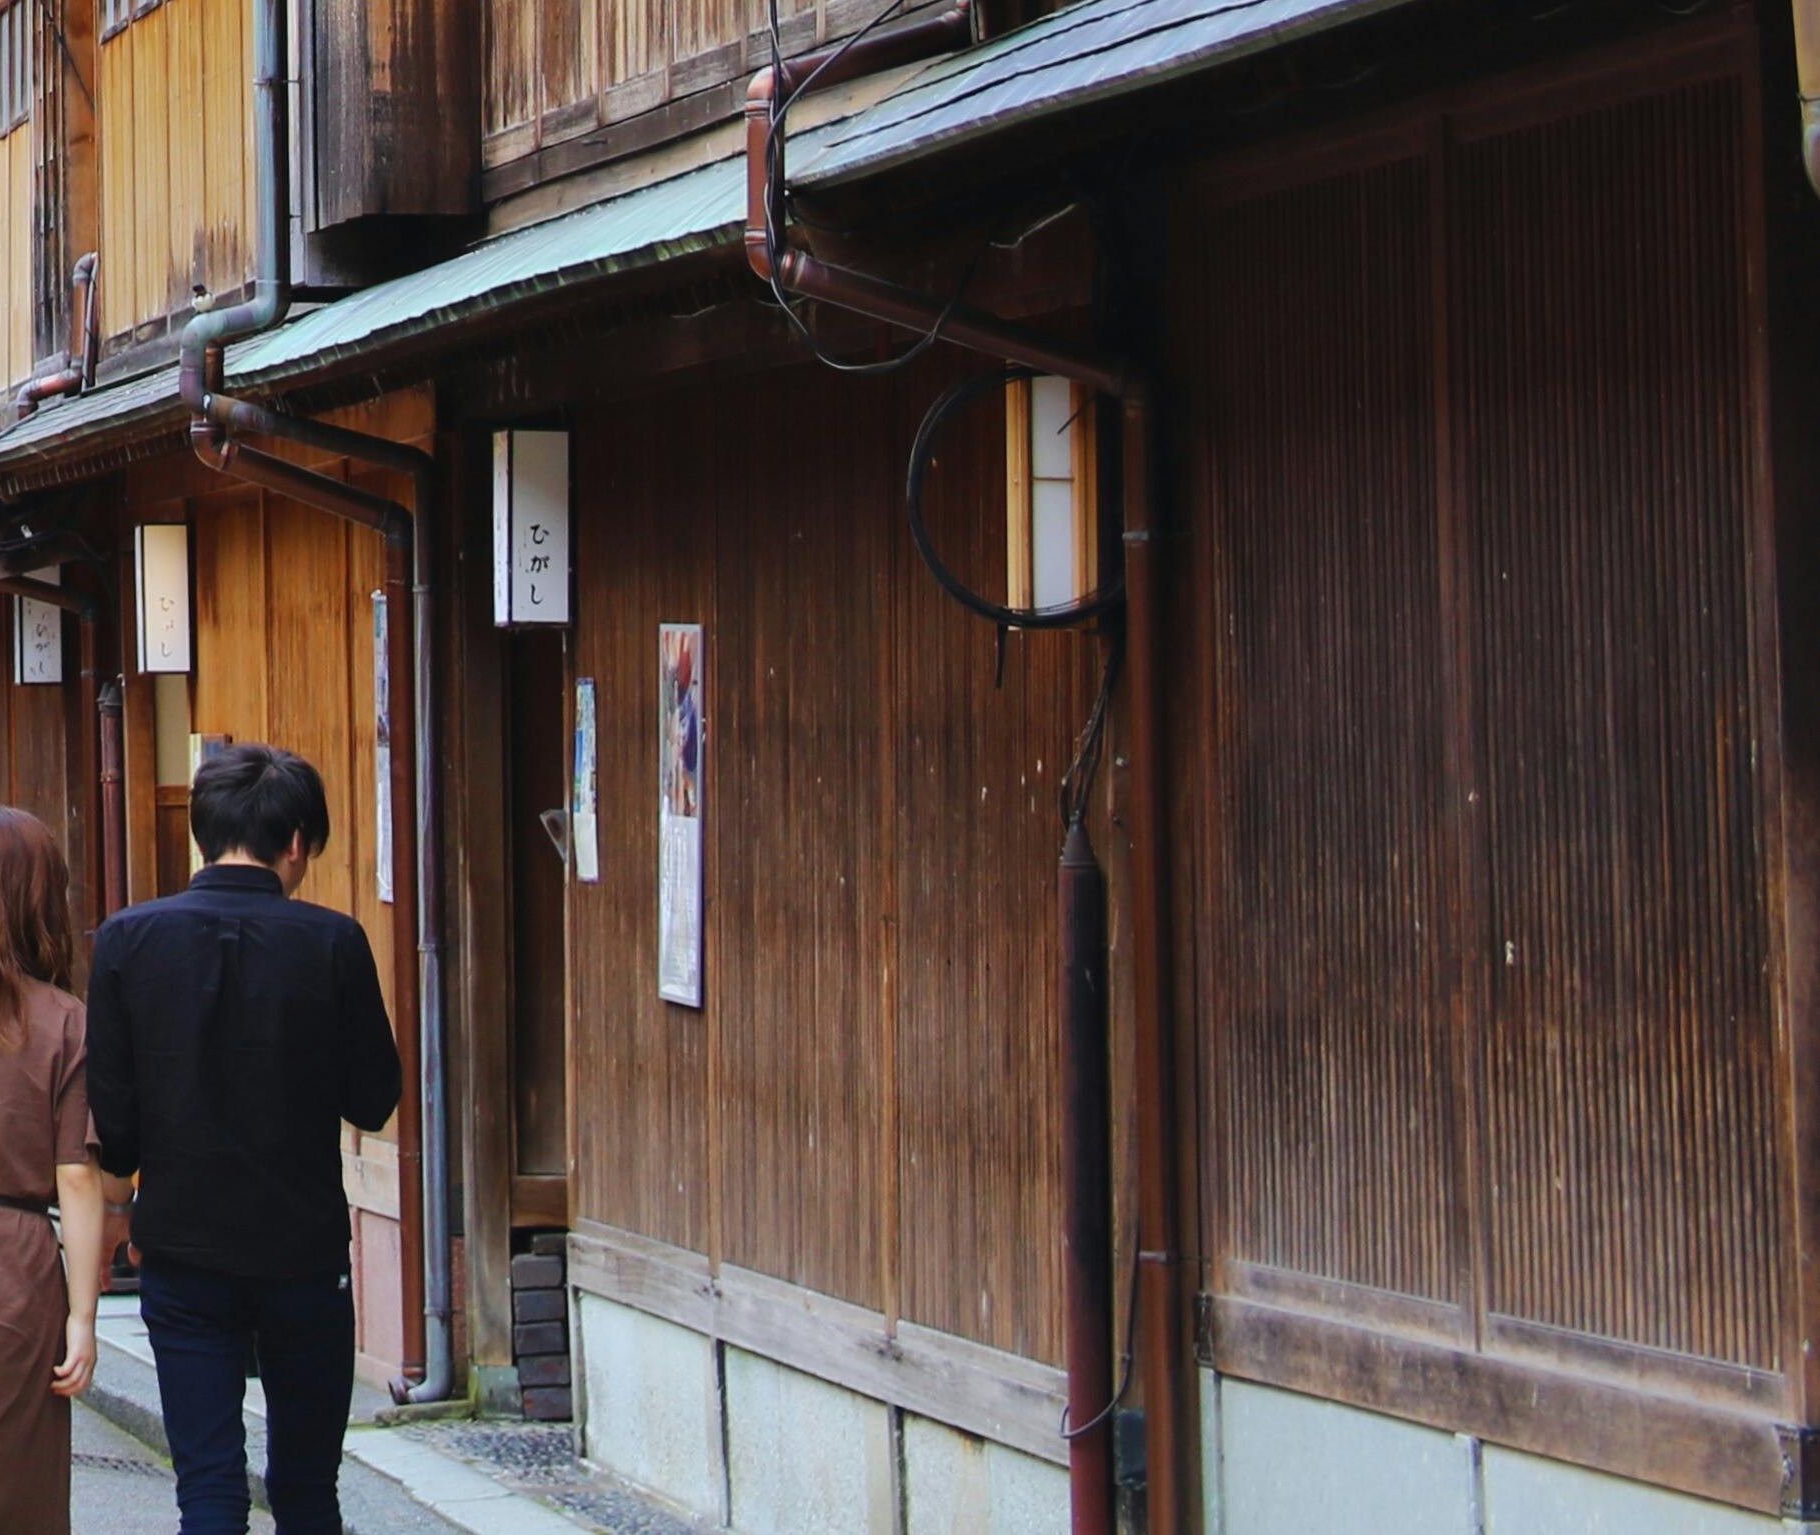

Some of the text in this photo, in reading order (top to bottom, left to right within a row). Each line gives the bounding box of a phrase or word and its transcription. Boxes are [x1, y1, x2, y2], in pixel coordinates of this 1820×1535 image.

[529, 523, 549, 605] ひがし
[160, 596, 175, 658] ひがし
